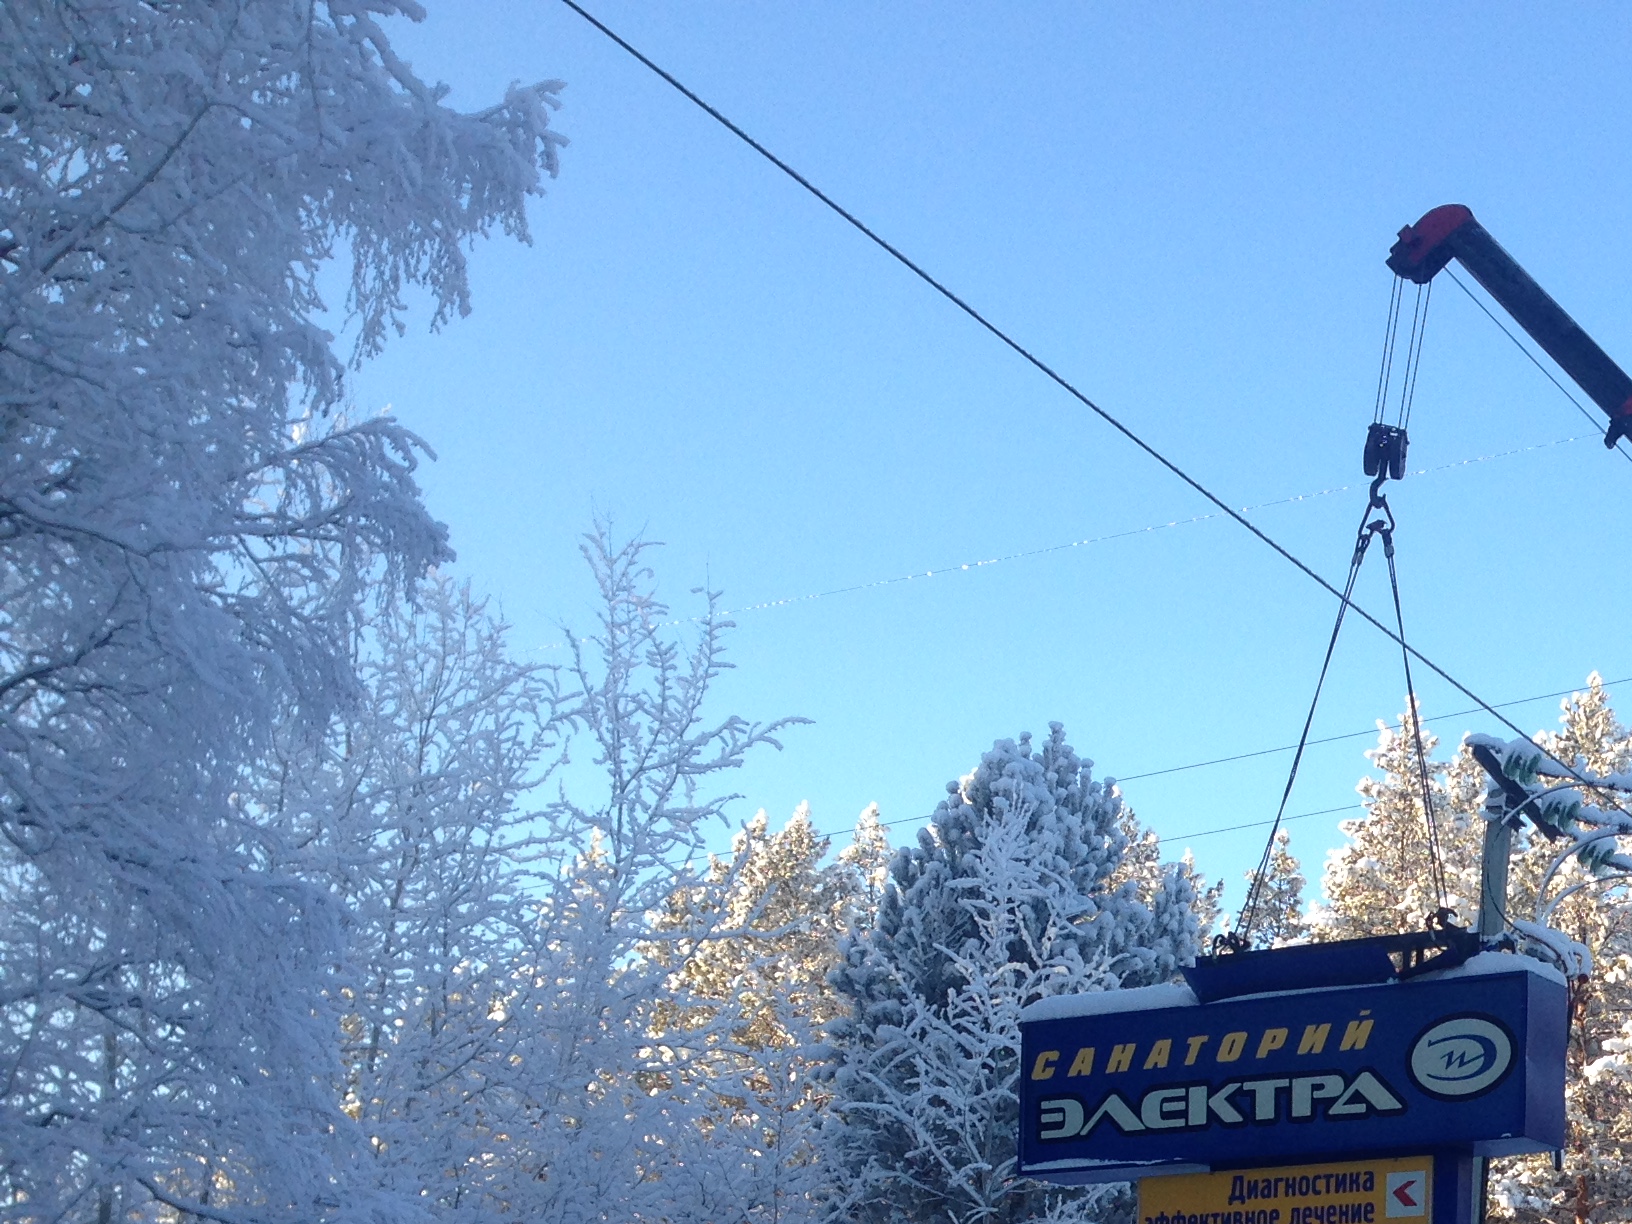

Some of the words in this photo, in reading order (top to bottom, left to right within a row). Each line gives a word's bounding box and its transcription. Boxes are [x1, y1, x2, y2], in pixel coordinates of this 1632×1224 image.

[1031, 1009, 1375, 1081] САНАТОРИЙ
[1040, 1070, 1403, 1140] ЭЛЕКТРА
[1228, 1170, 1375, 1205] Диагностика
